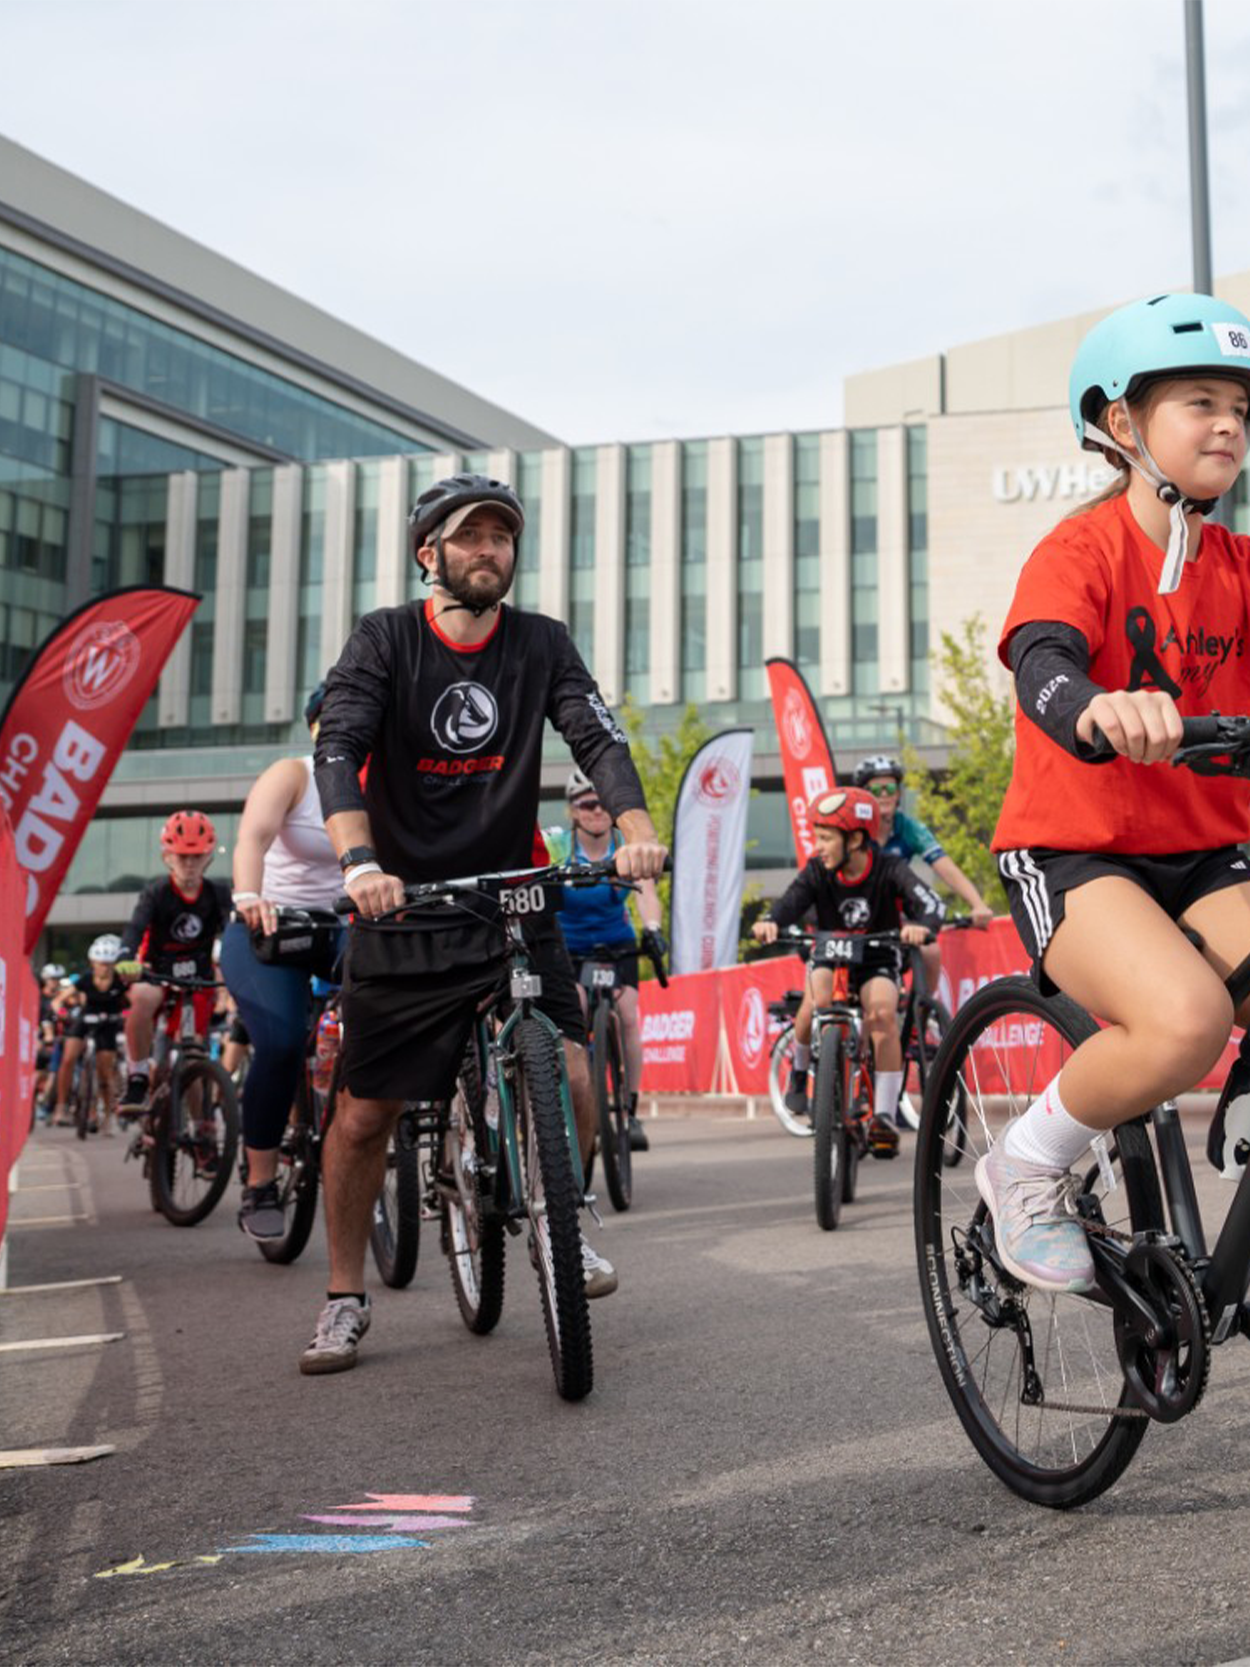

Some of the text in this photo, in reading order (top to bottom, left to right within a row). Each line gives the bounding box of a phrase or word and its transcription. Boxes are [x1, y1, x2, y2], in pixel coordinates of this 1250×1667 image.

[1228, 330, 1248, 349] 86
[993, 462, 1123, 502] UWHe
[499, 885, 545, 914] 580
[927, 1256, 967, 1387] CONNECTION
